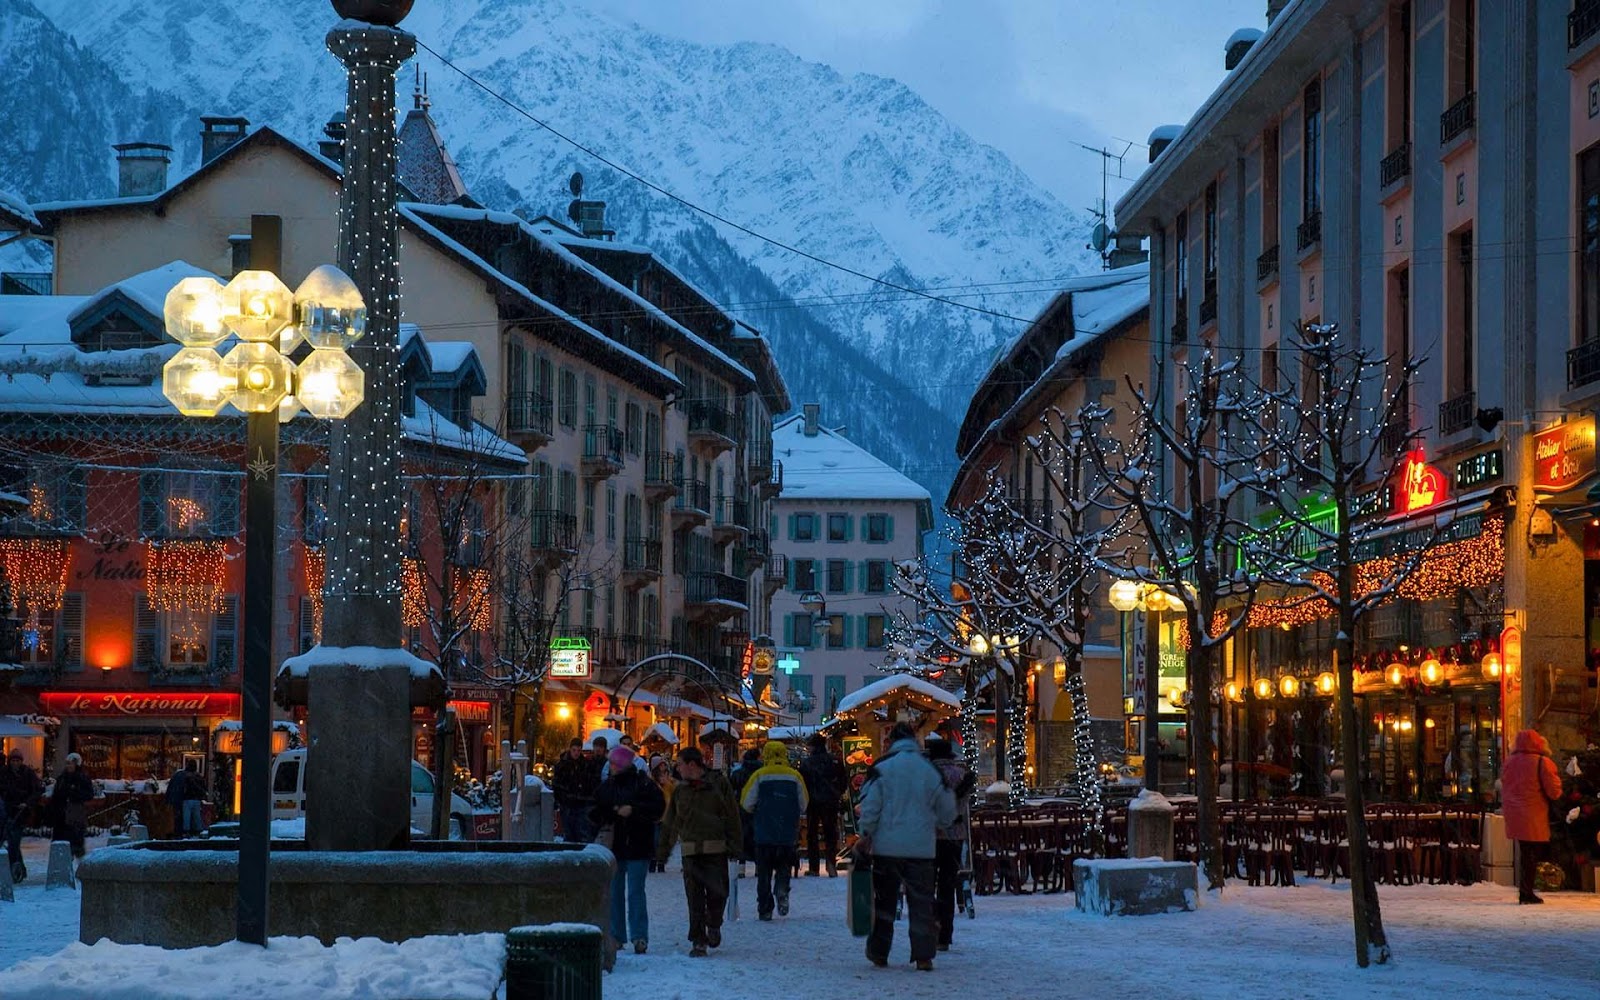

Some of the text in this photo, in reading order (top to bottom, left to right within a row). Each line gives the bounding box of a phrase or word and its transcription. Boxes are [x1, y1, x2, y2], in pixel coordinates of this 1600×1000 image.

[1536, 439, 1561, 460] Atelier
[1551, 461, 1560, 479] et
[76, 559, 148, 581] Natio
[741, 641, 754, 678] TABAC
[1135, 608, 1146, 711] CINEMA
[1160, 660, 1185, 668] NEIGE
[69, 694, 209, 714] le National
